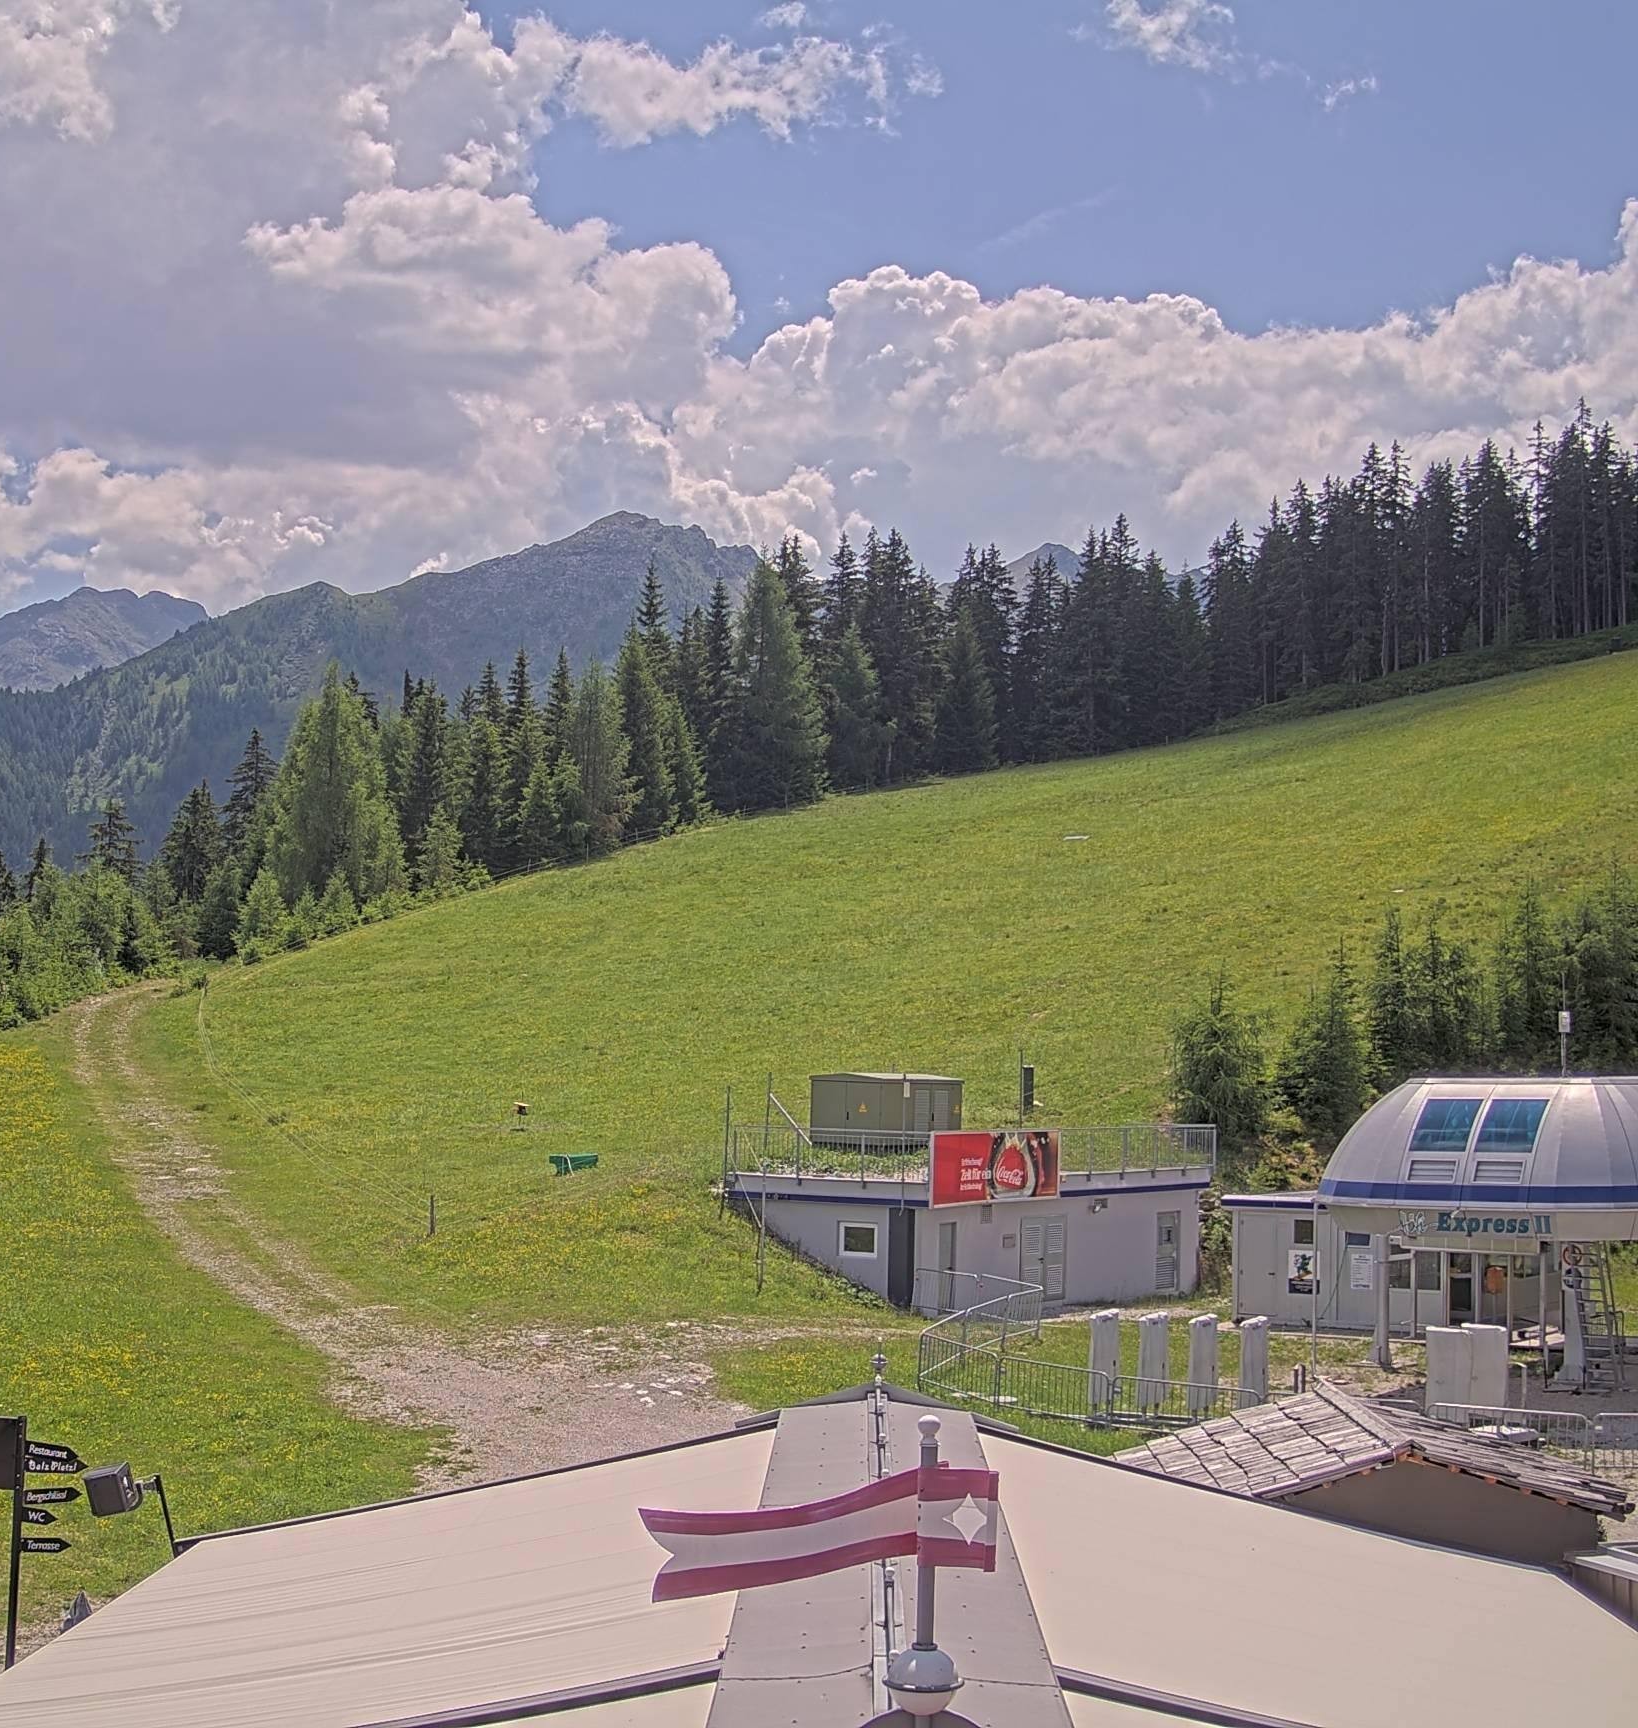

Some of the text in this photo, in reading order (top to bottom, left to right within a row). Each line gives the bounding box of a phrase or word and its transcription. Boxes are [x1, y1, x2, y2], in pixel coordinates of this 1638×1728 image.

[1436, 1212, 1530, 1237] Express
[28, 1444, 68, 1459] Restaurant
[28, 1511, 46, 1522] WC
[26, 1540, 61, 1551] Terrasse
